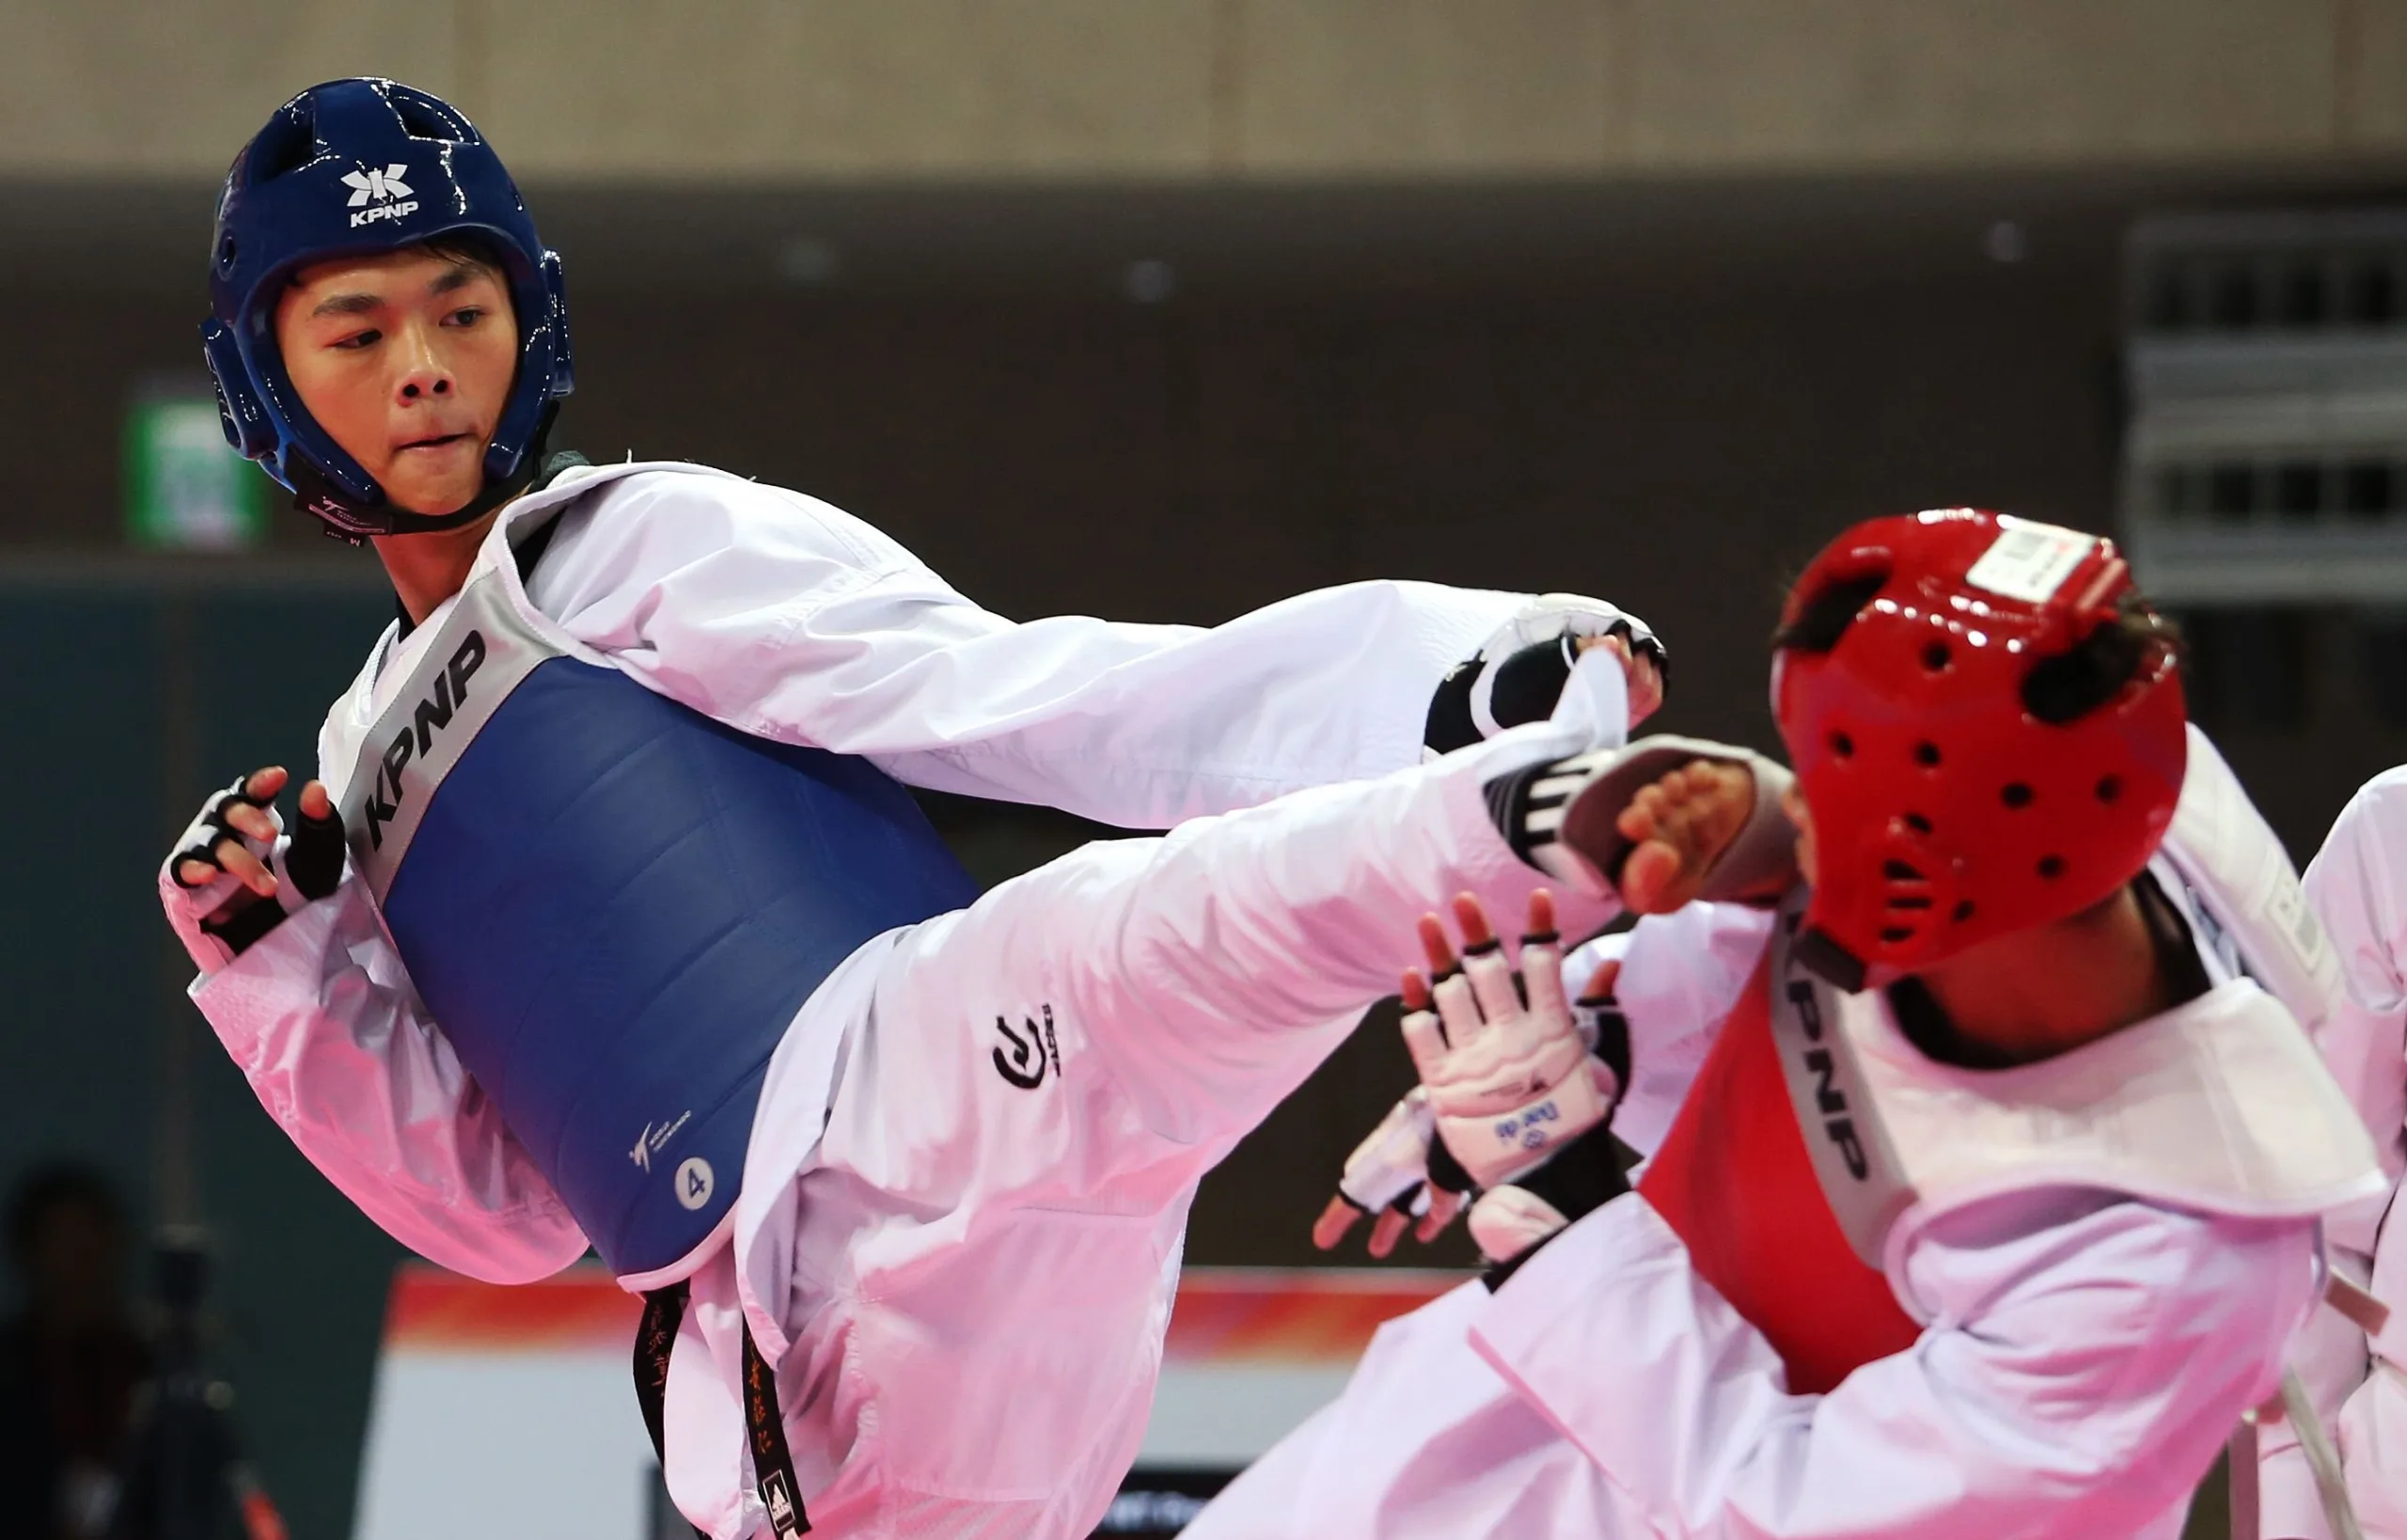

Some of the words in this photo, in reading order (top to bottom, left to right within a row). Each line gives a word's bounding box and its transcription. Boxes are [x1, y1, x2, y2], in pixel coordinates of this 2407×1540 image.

[350, 200, 419, 228] KPNP
[365, 629, 486, 853] KPNP
[687, 1167, 705, 1199] 4
